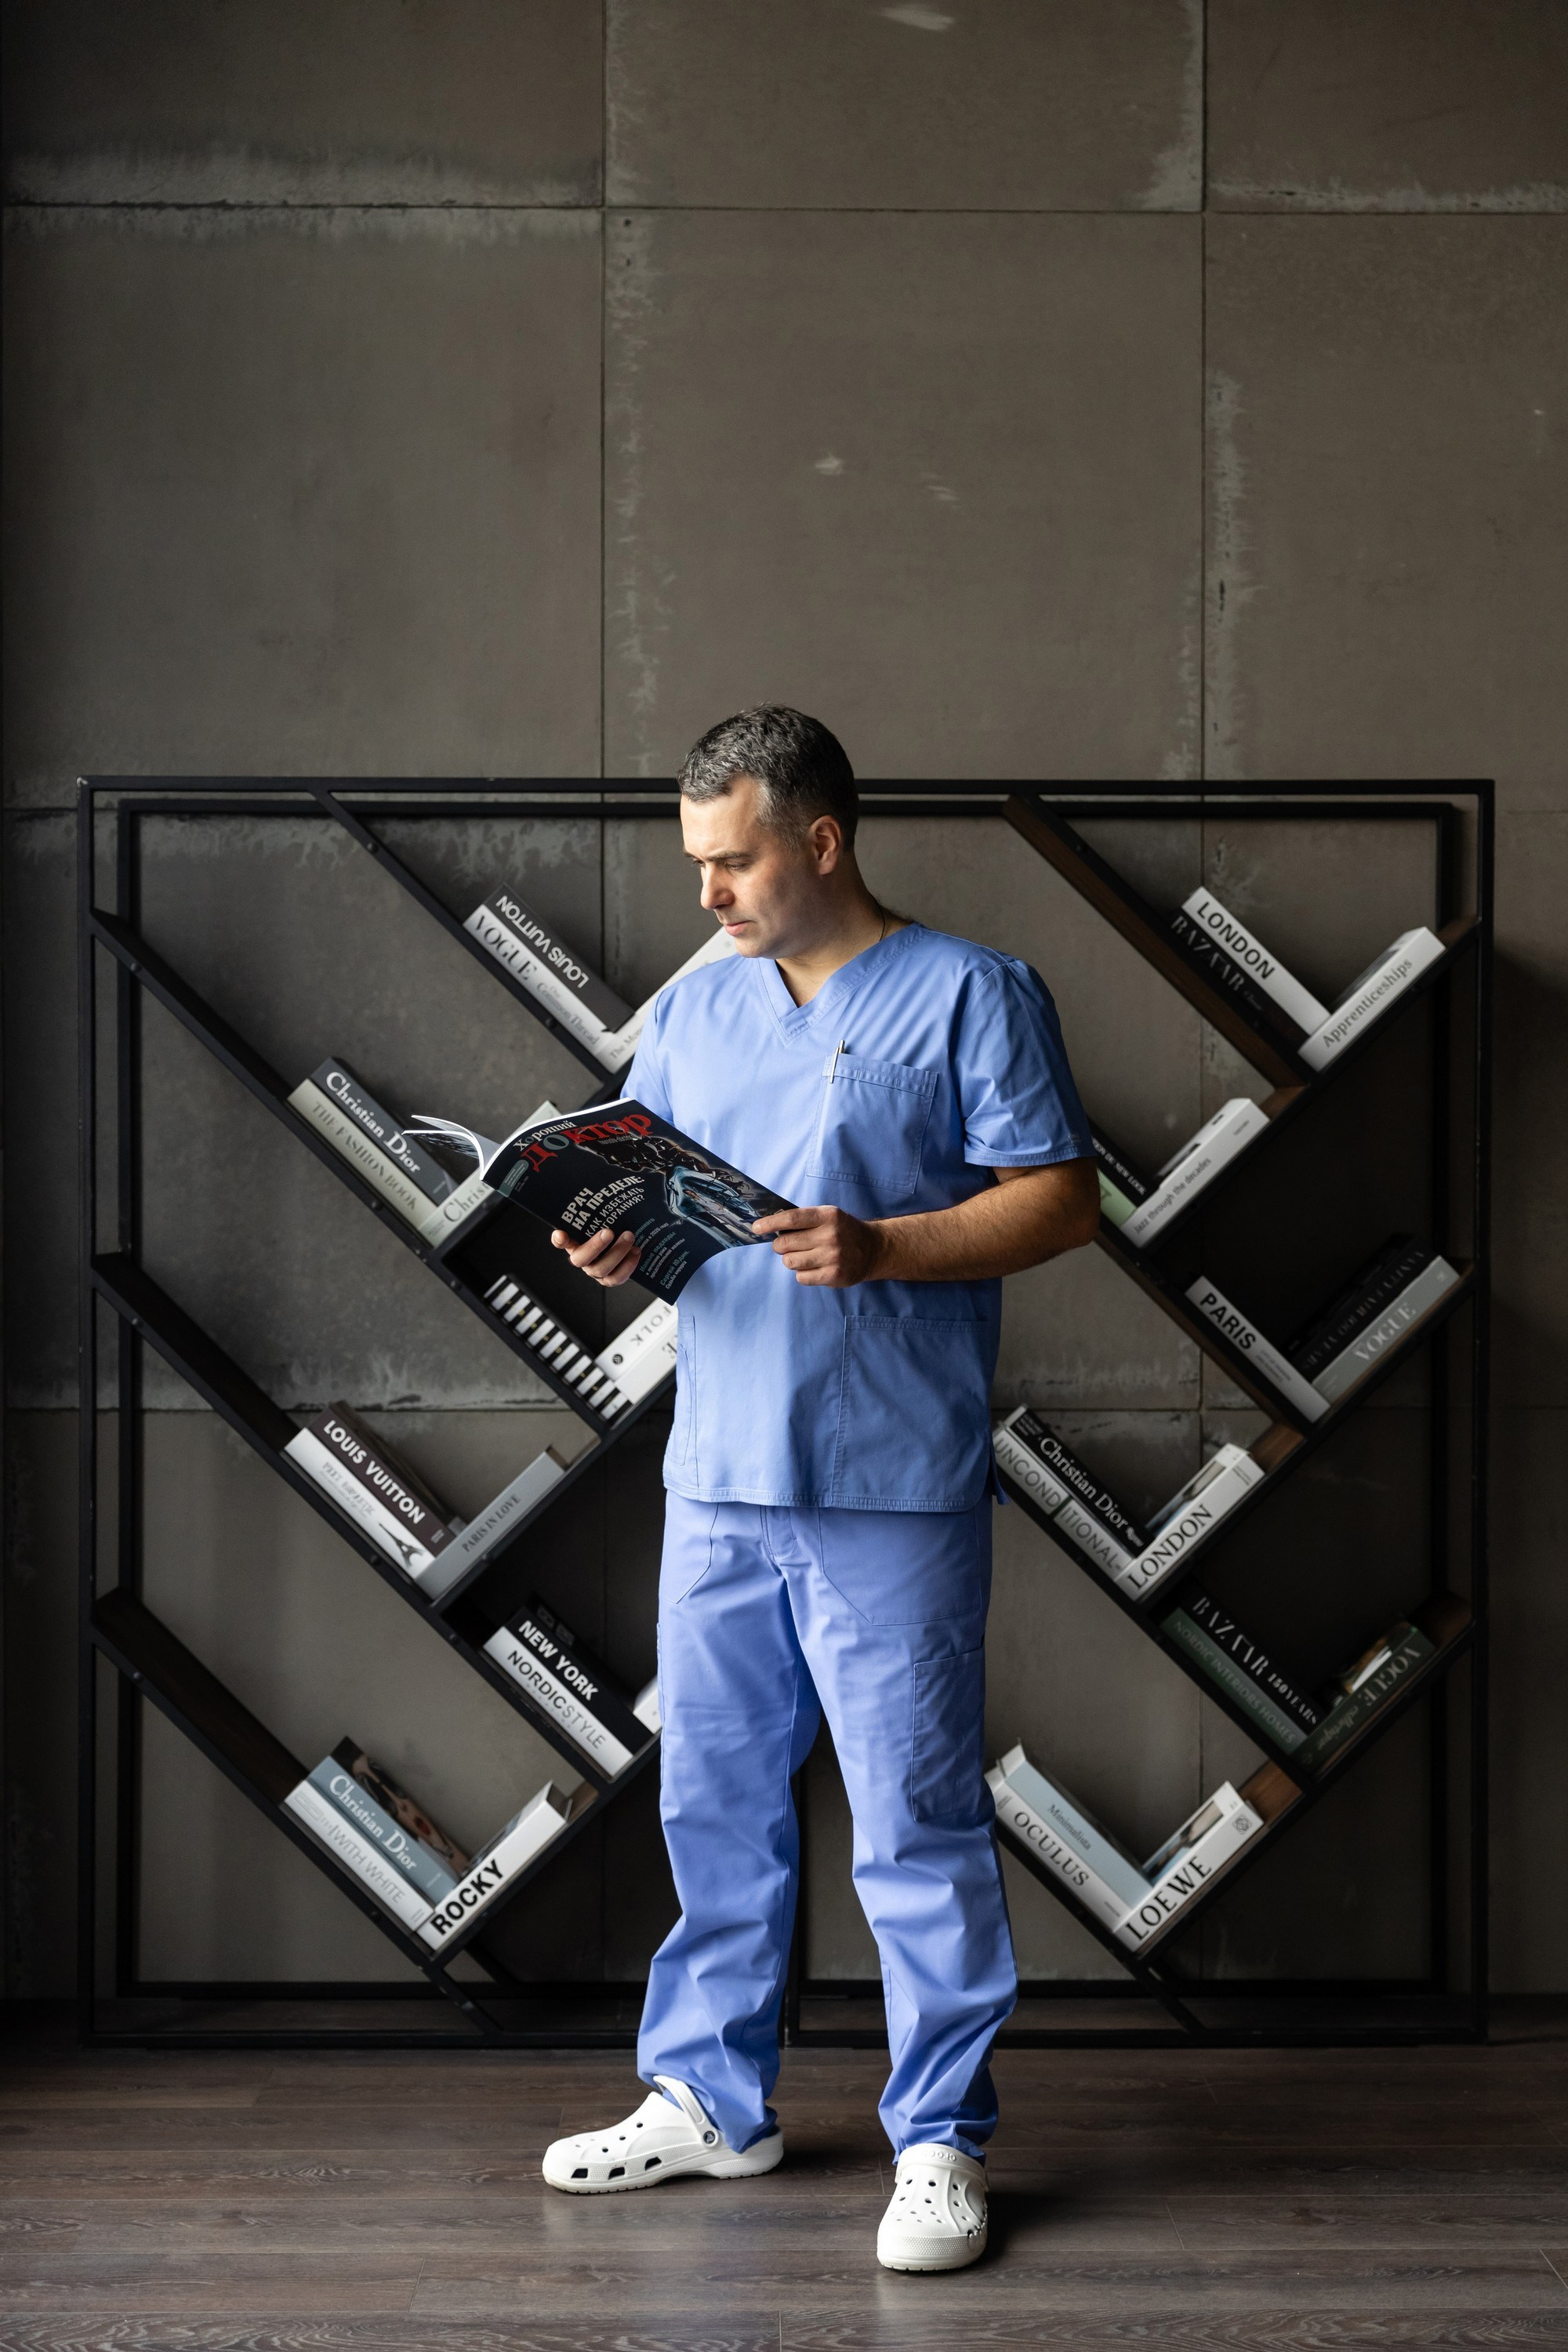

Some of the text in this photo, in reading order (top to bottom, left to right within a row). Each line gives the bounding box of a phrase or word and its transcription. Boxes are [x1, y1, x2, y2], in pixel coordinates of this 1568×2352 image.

[474, 915, 538, 981] VOGUE
[495, 895, 590, 989] LOUIS VUITTON
[1171, 915, 1246, 992] BAZAAR
[1196, 900, 1276, 980] LONDON
[1322, 957, 1414, 1049] Apprenticeships
[312, 1101, 418, 1210] THE FASHION BOOK
[325, 1071, 421, 1174] Christian Dior
[512, 1120, 578, 1151] Хороший
[561, 1187, 594, 1224] ВРАЧ
[572, 1175, 645, 1231] НА ПРЕДЕЛЕ:
[585, 1187, 644, 1238] КАК ИЗБЕЖАТЬ
[1127, 1174, 1148, 1196] LOOK
[660, 1265, 676, 1286] Сергей
[629, 1305, 672, 1347] FOLK
[1199, 1292, 1258, 1351] PARIS
[1353, 1301, 1417, 1362] VOGUE
[322, 1419, 367, 1465] LOUIS
[364, 1459, 426, 1525] VUITTON
[1040, 1436, 1130, 1530] Christian Dior
[461, 1526, 488, 1552] PARIS
[483, 1512, 500, 1530] IN
[495, 1494, 522, 1520] LOVE
[1126, 1503, 1214, 1590] LONDON
[517, 1619, 600, 1701] NEW YORK
[1174, 1620, 1217, 1664] NORDIC
[1192, 1596, 1270, 1676] BAZAAR
[1357, 1645, 1422, 1708] VOGUE
[328, 1773, 419, 1872] Christian Dior
[1013, 1810, 1091, 1887] OCULUS
[332, 1825, 407, 1905] WITH WHITE
[430, 1858, 505, 1936] ROCKY
[1124, 1855, 1213, 1943] LOEWE
